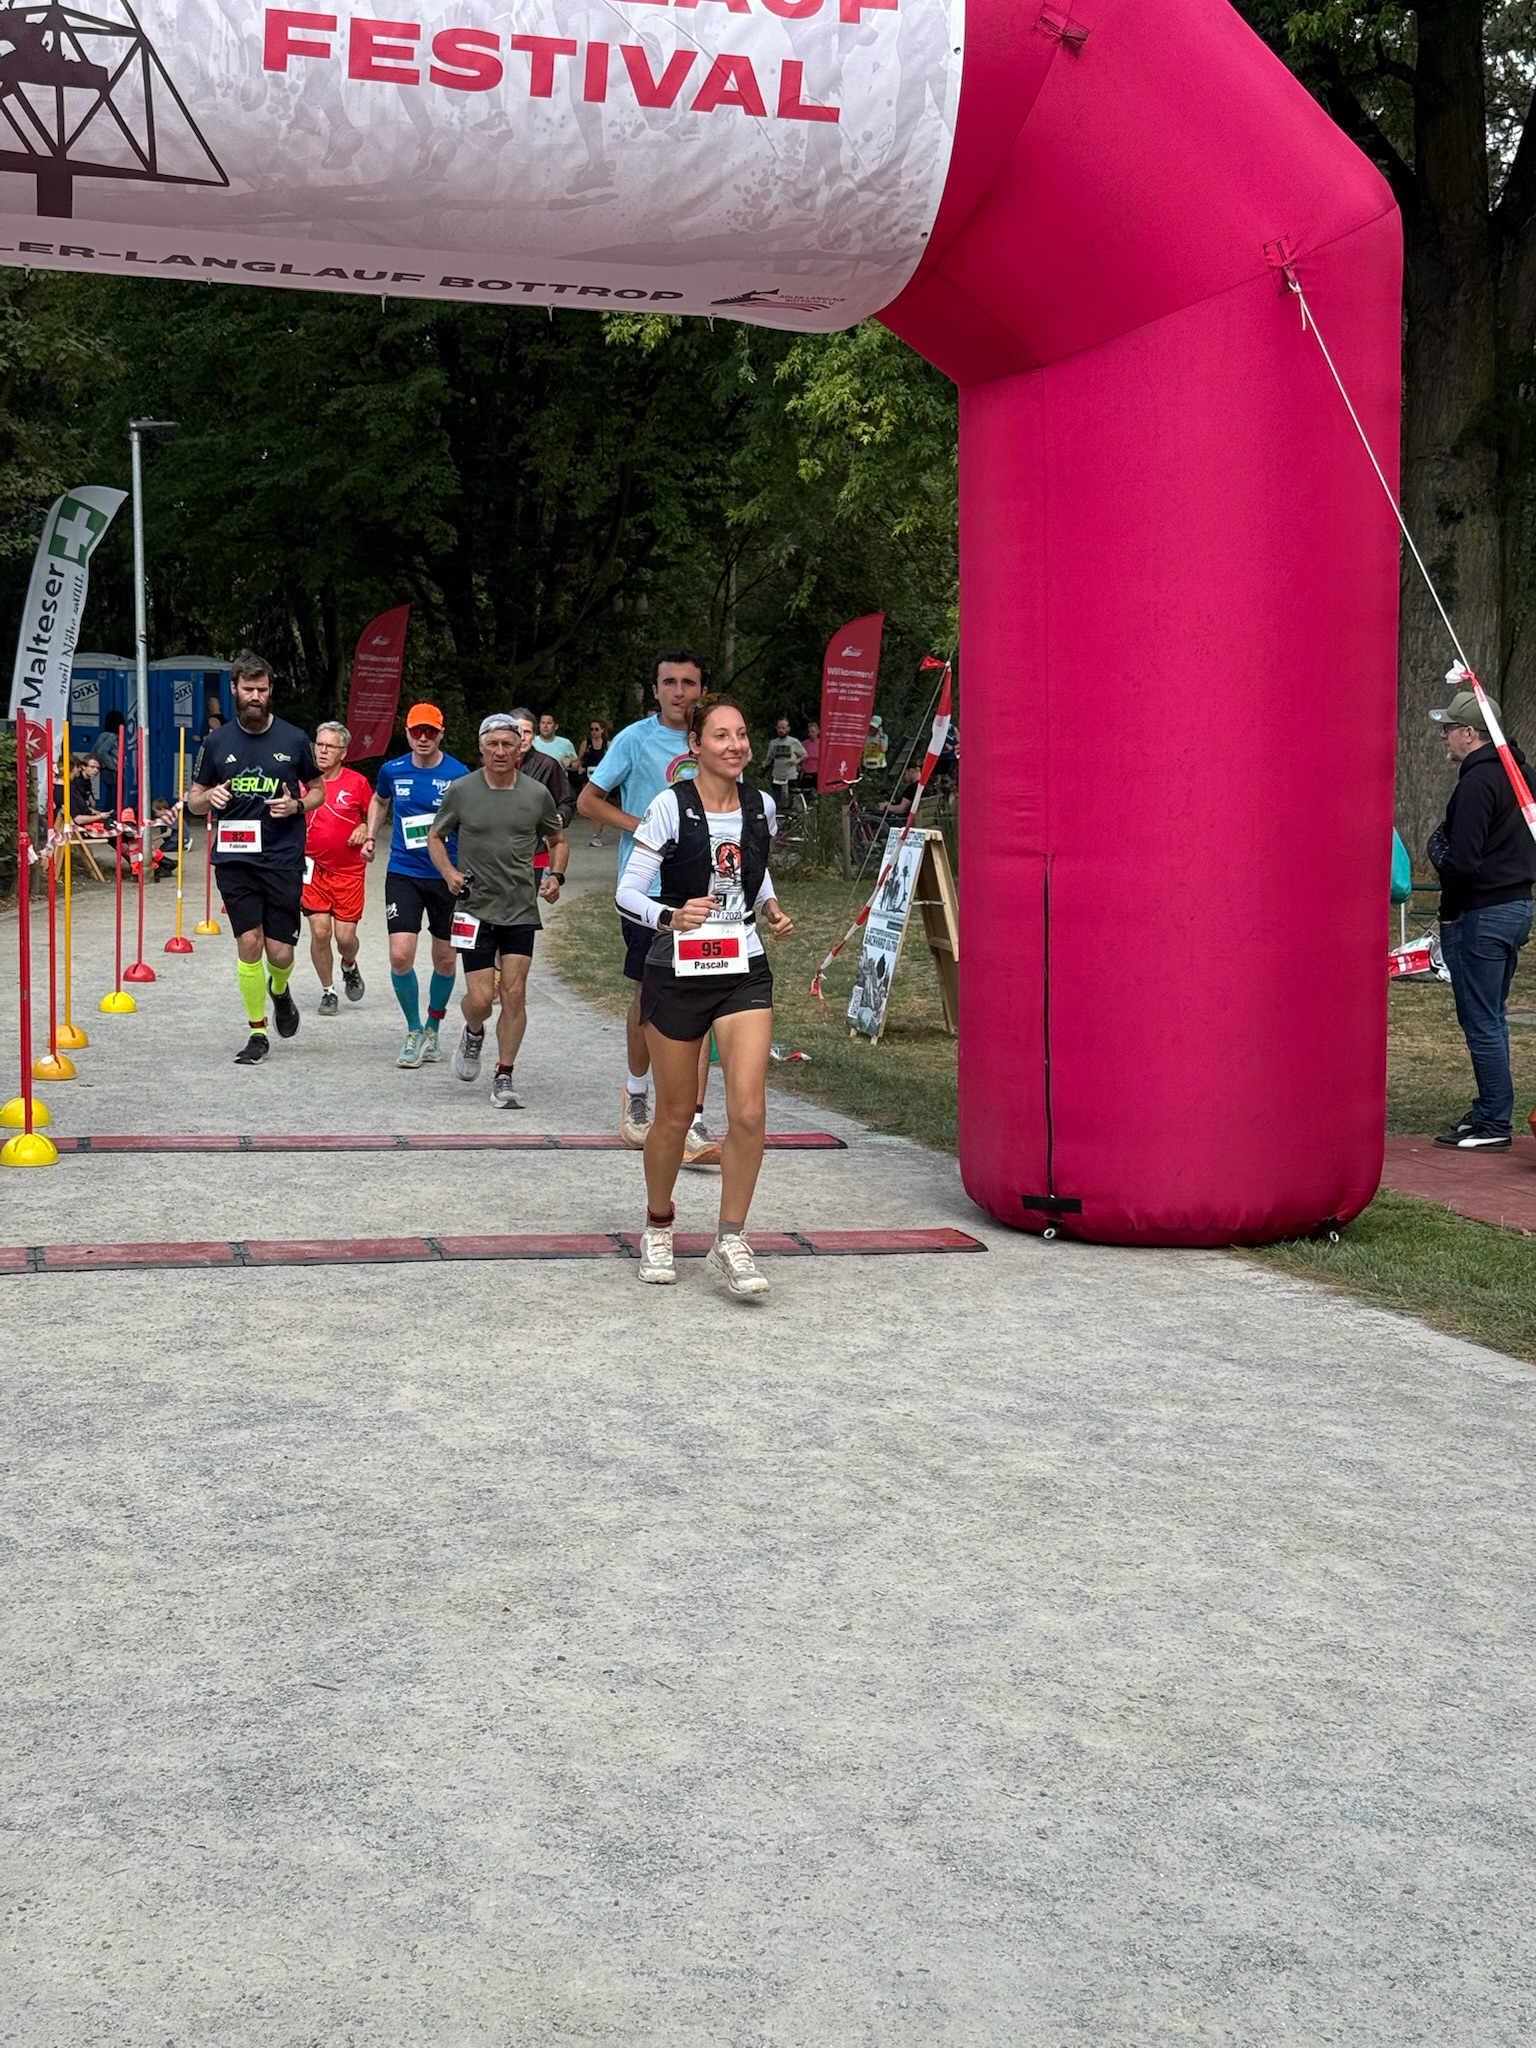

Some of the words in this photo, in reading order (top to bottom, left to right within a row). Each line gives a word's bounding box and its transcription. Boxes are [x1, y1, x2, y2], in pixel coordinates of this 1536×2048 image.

[263, 8, 841, 123] FESTIVAL
[439, 276, 684, 301] BOTTROP
[20, 563, 65, 708] Malteser
[72, 682, 99, 700] DIXI
[174, 682, 193, 701] DIXI
[231, 777, 280, 793] BERLIN
[701, 941, 722, 957] 95
[694, 960, 729, 970] Pascale
